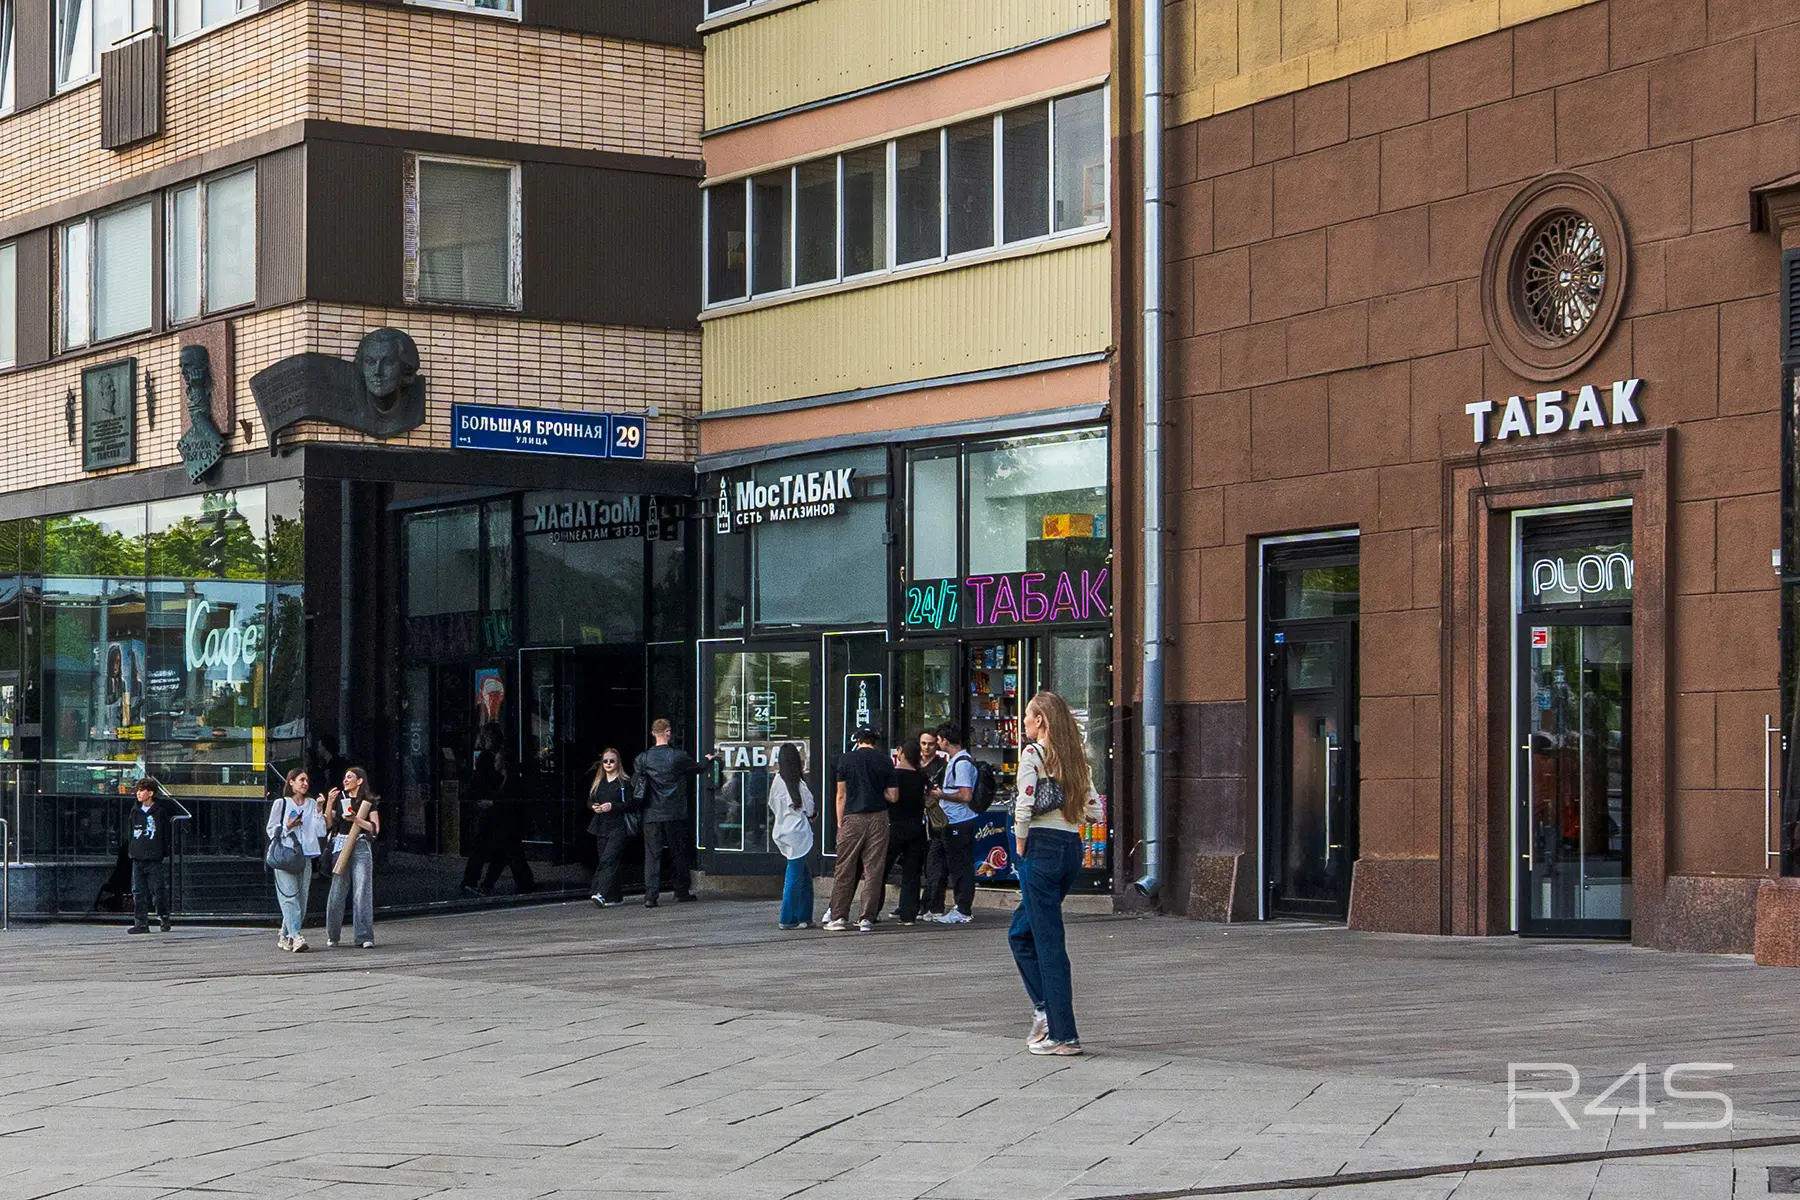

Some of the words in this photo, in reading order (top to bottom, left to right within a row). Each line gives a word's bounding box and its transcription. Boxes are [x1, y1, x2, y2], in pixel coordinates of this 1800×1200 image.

[461, 415, 531, 435] БОЛЬШАЯ
[537, 420, 602, 439] БРОННАЯ
[1465, 379, 1640, 443] ТАБАК
[516, 436, 548, 445] УЛИЦА
[616, 426, 640, 448] 29
[736, 468, 852, 511] МосТАБАК
[736, 511, 763, 526] СЕТЬ
[770, 503, 836, 522] МАГАЗИНОВ
[1533, 553, 1634, 595] PLON
[908, 579, 957, 629] 24/7
[966, 568, 1109, 624] ТАБАК
[185, 599, 257, 684] Кафе
[754, 707, 770, 717] 24
[720, 746, 803, 768] ТАБА
